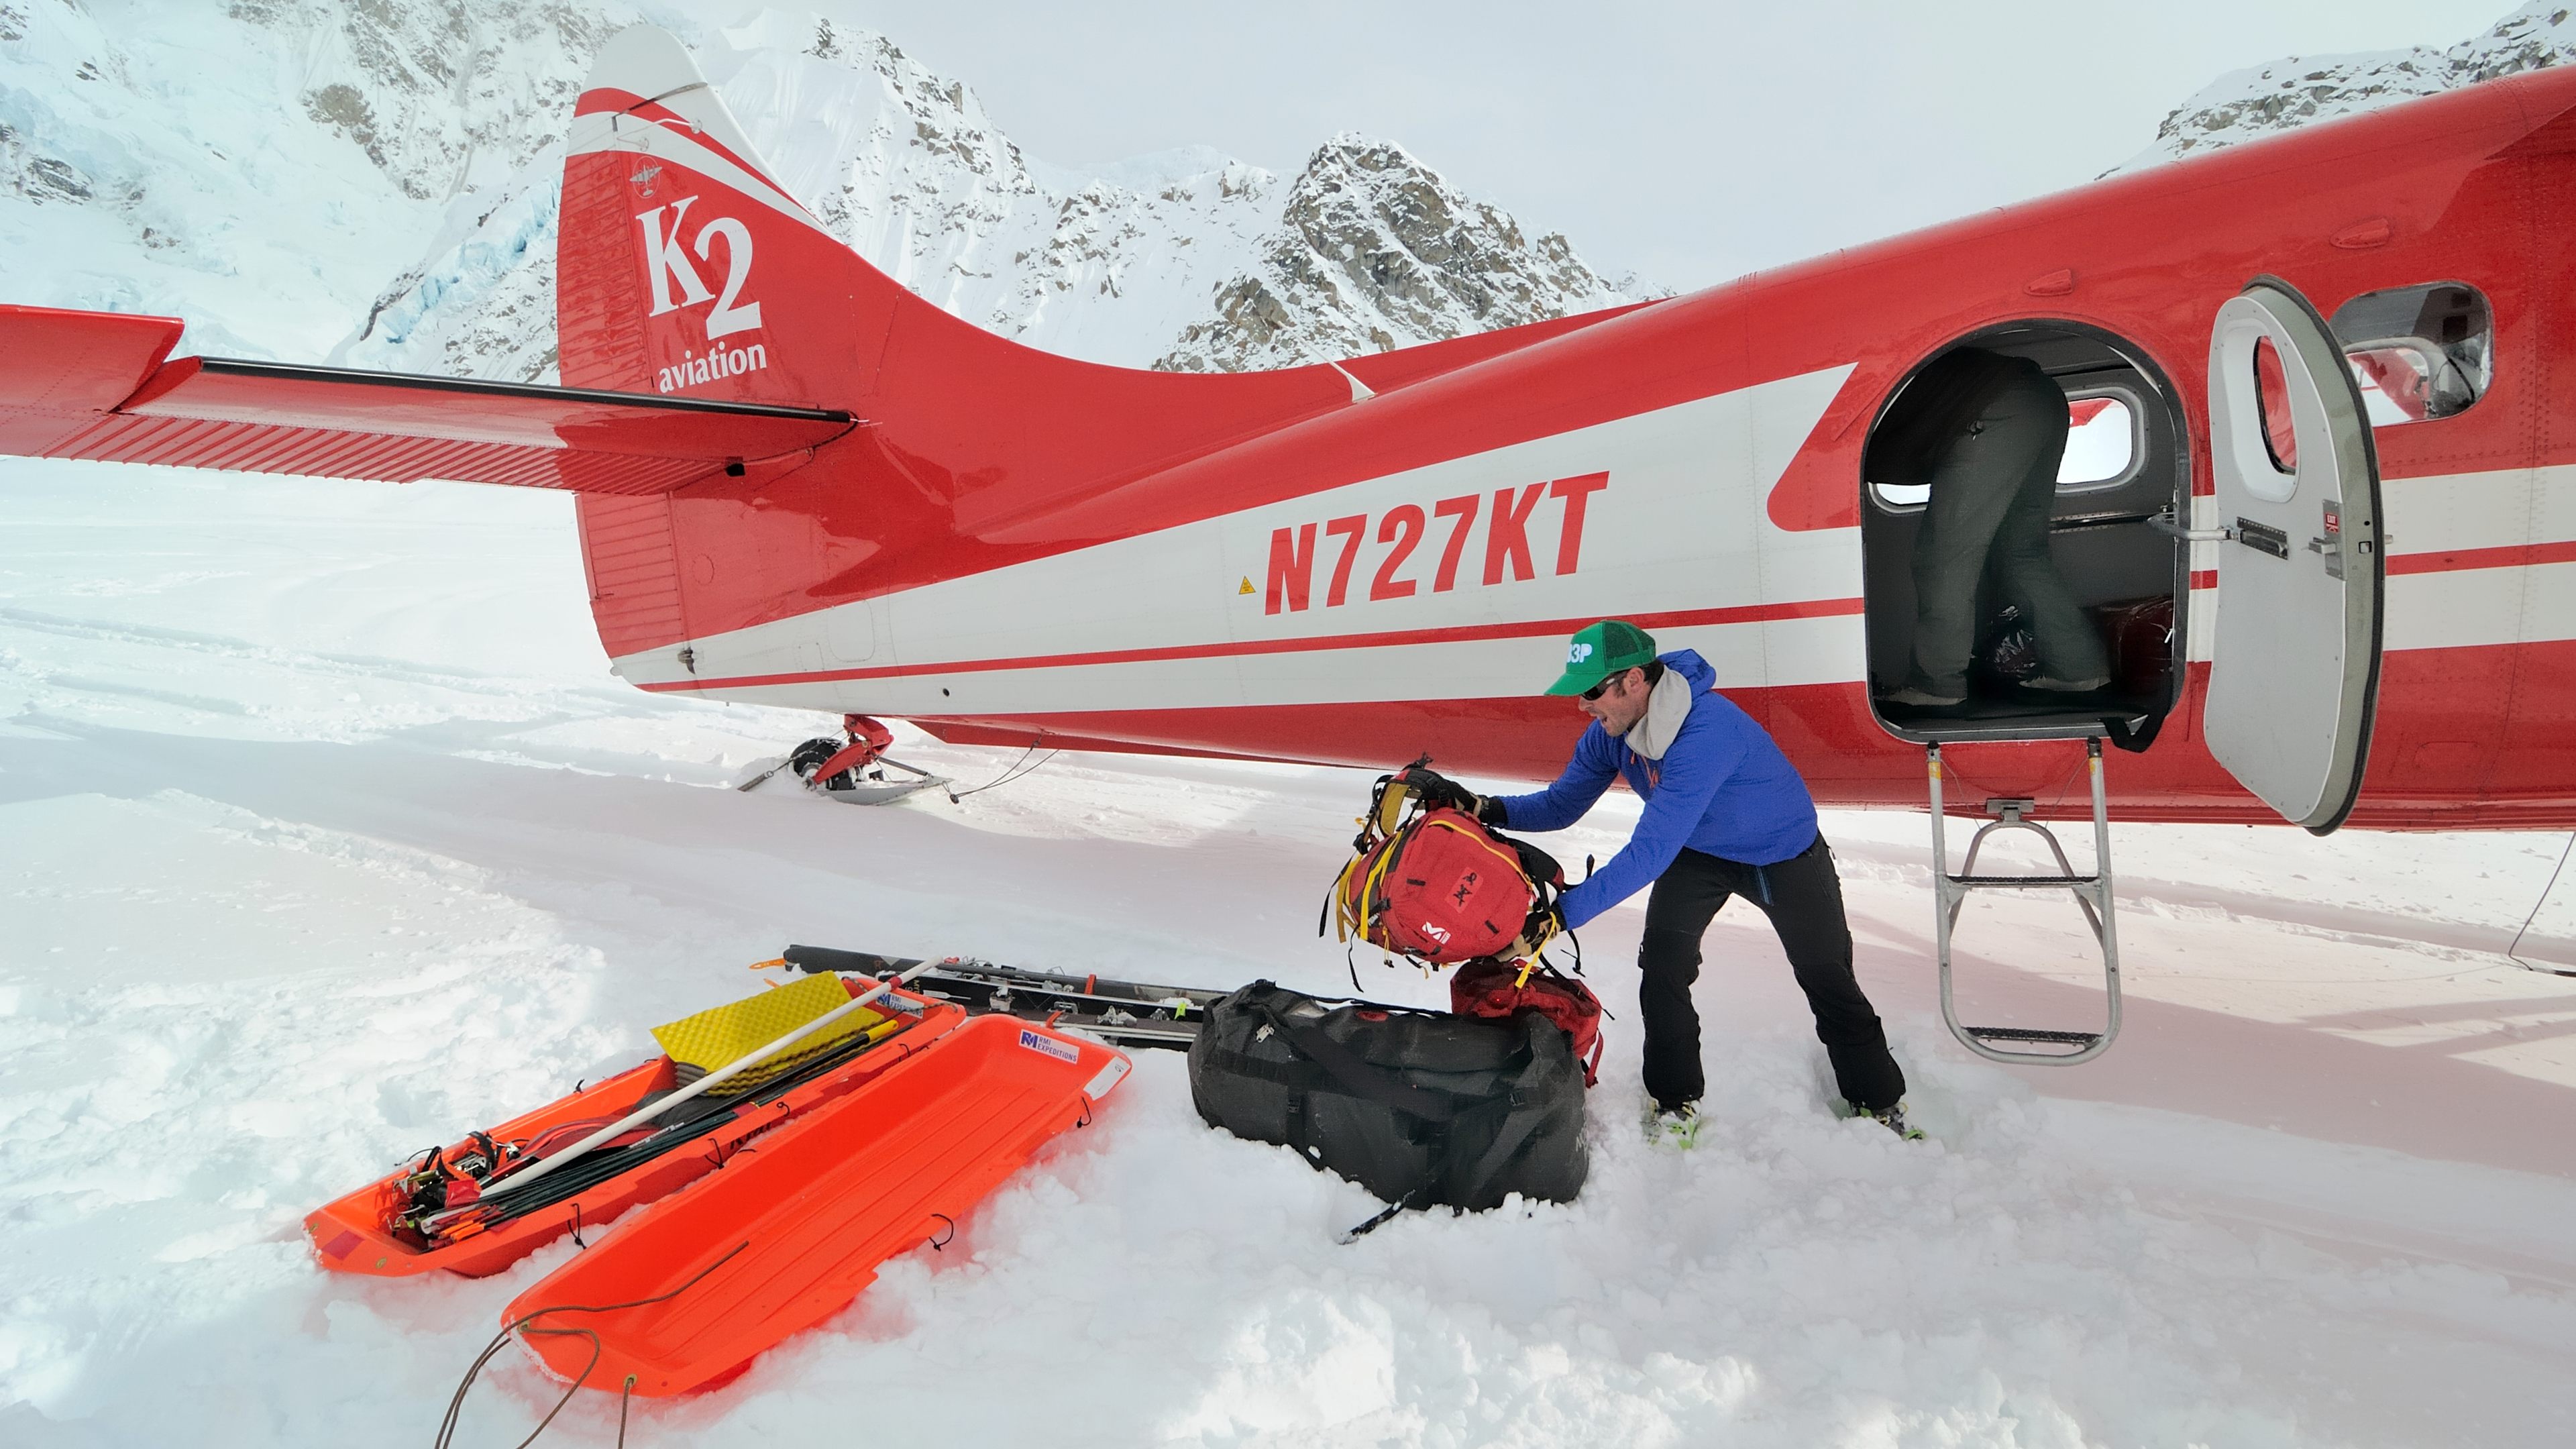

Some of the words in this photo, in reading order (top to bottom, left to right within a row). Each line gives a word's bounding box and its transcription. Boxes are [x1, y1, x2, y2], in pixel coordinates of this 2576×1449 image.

[635, 195, 762, 341] K2
[659, 341, 767, 394] aviation
[1265, 470, 1610, 616] N727KT
[1566, 643, 1593, 663] 3P
[1037, 1043, 1077, 1063] EXPEDITIONS
[1038, 1036, 1051, 1045] RMI
